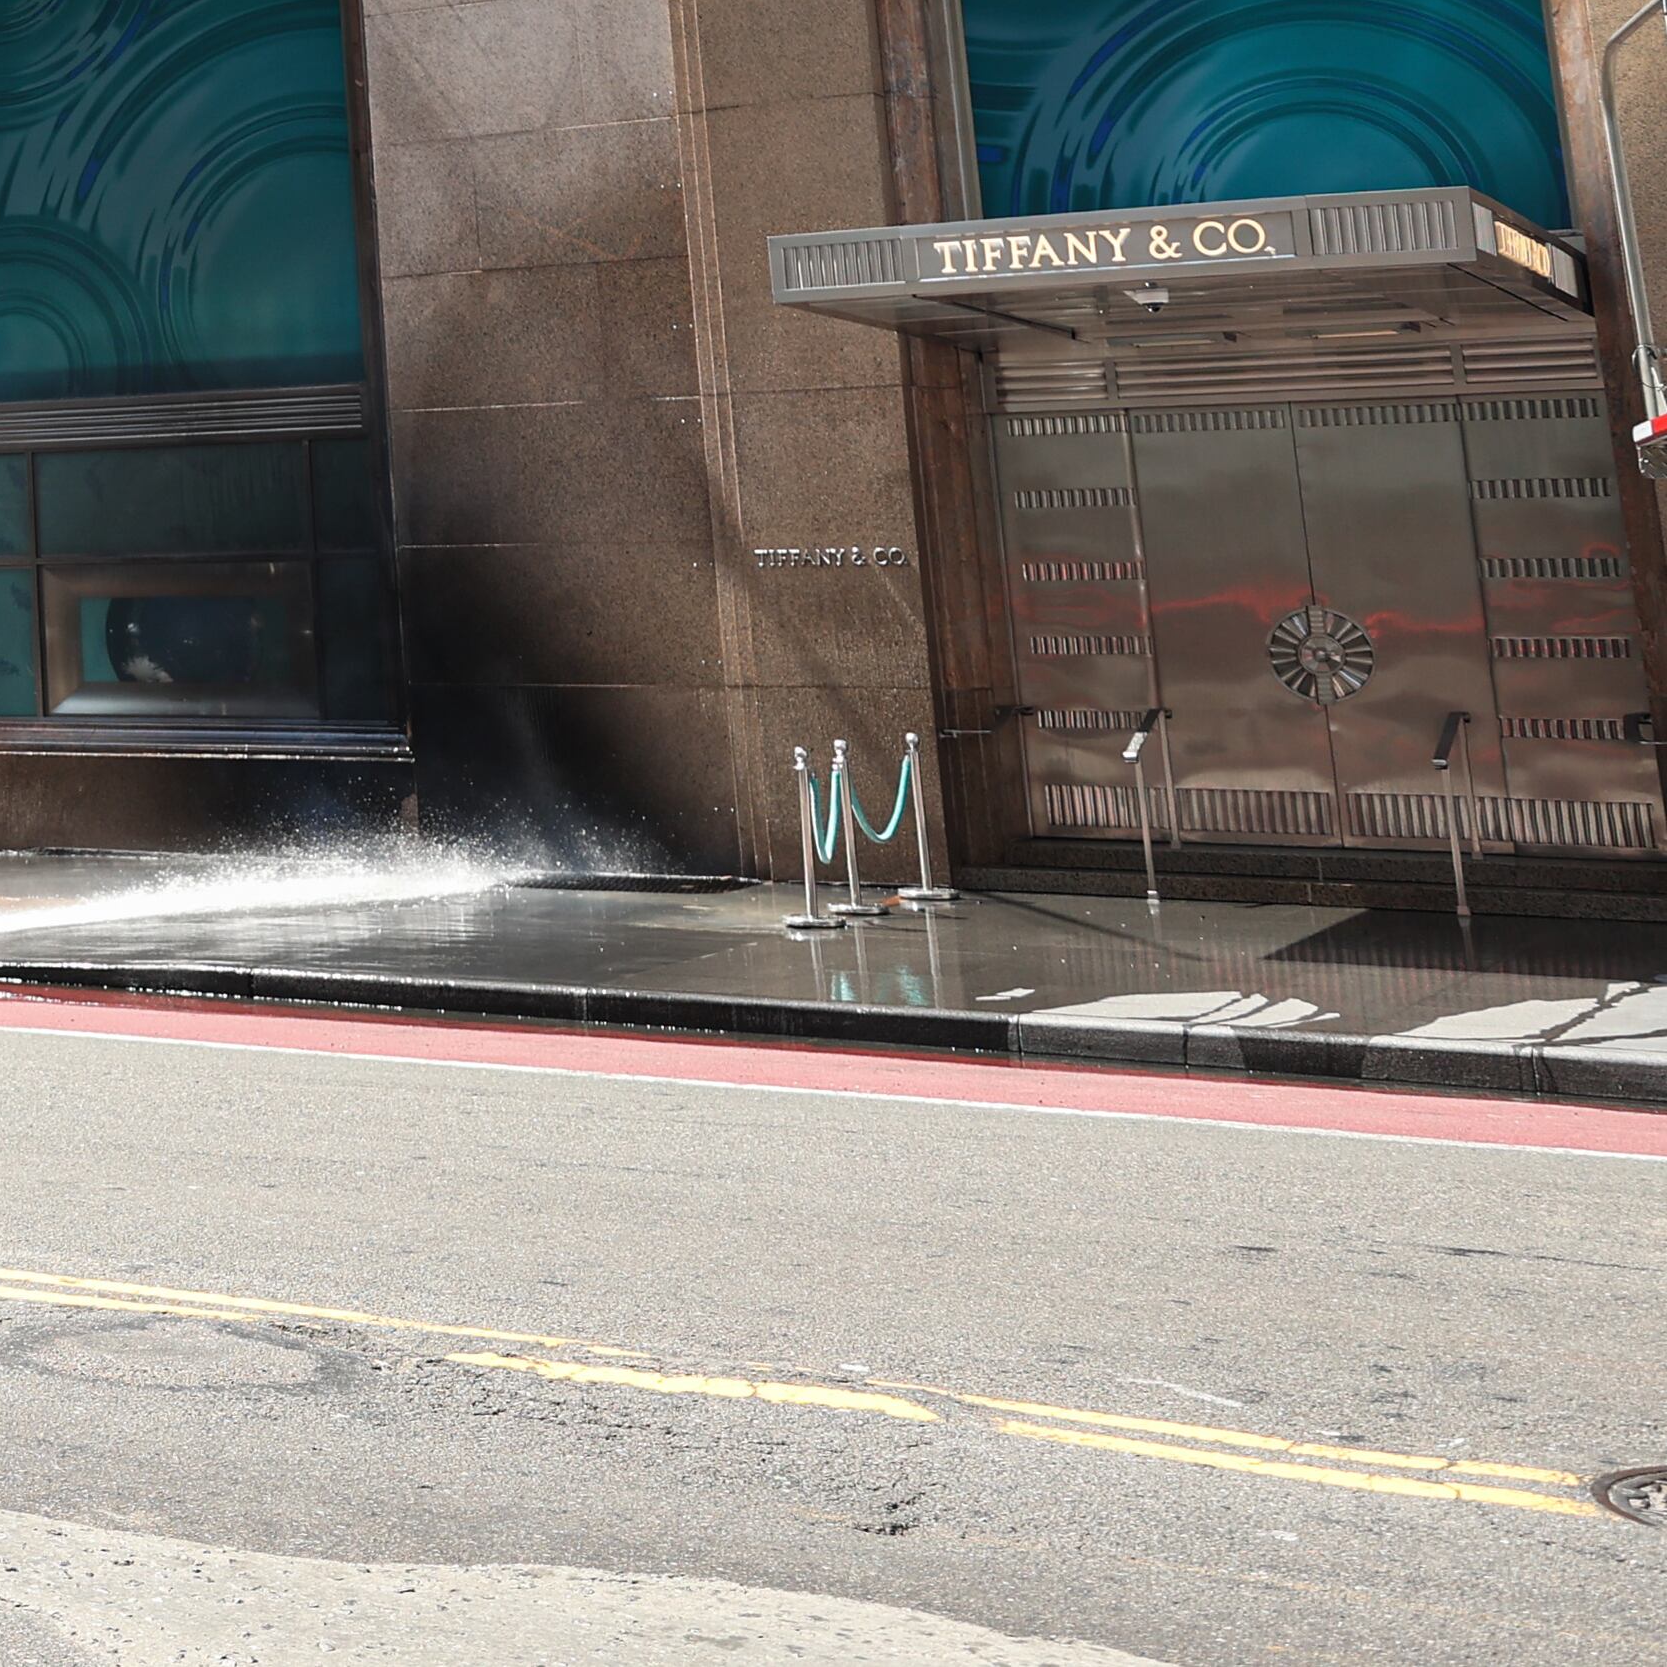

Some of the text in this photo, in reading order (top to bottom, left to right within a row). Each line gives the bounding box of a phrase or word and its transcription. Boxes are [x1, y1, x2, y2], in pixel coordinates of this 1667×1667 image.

[933, 217, 1276, 277] TIFFANY & CO.
[753, 546, 909, 568] TIFFANY & CO.
